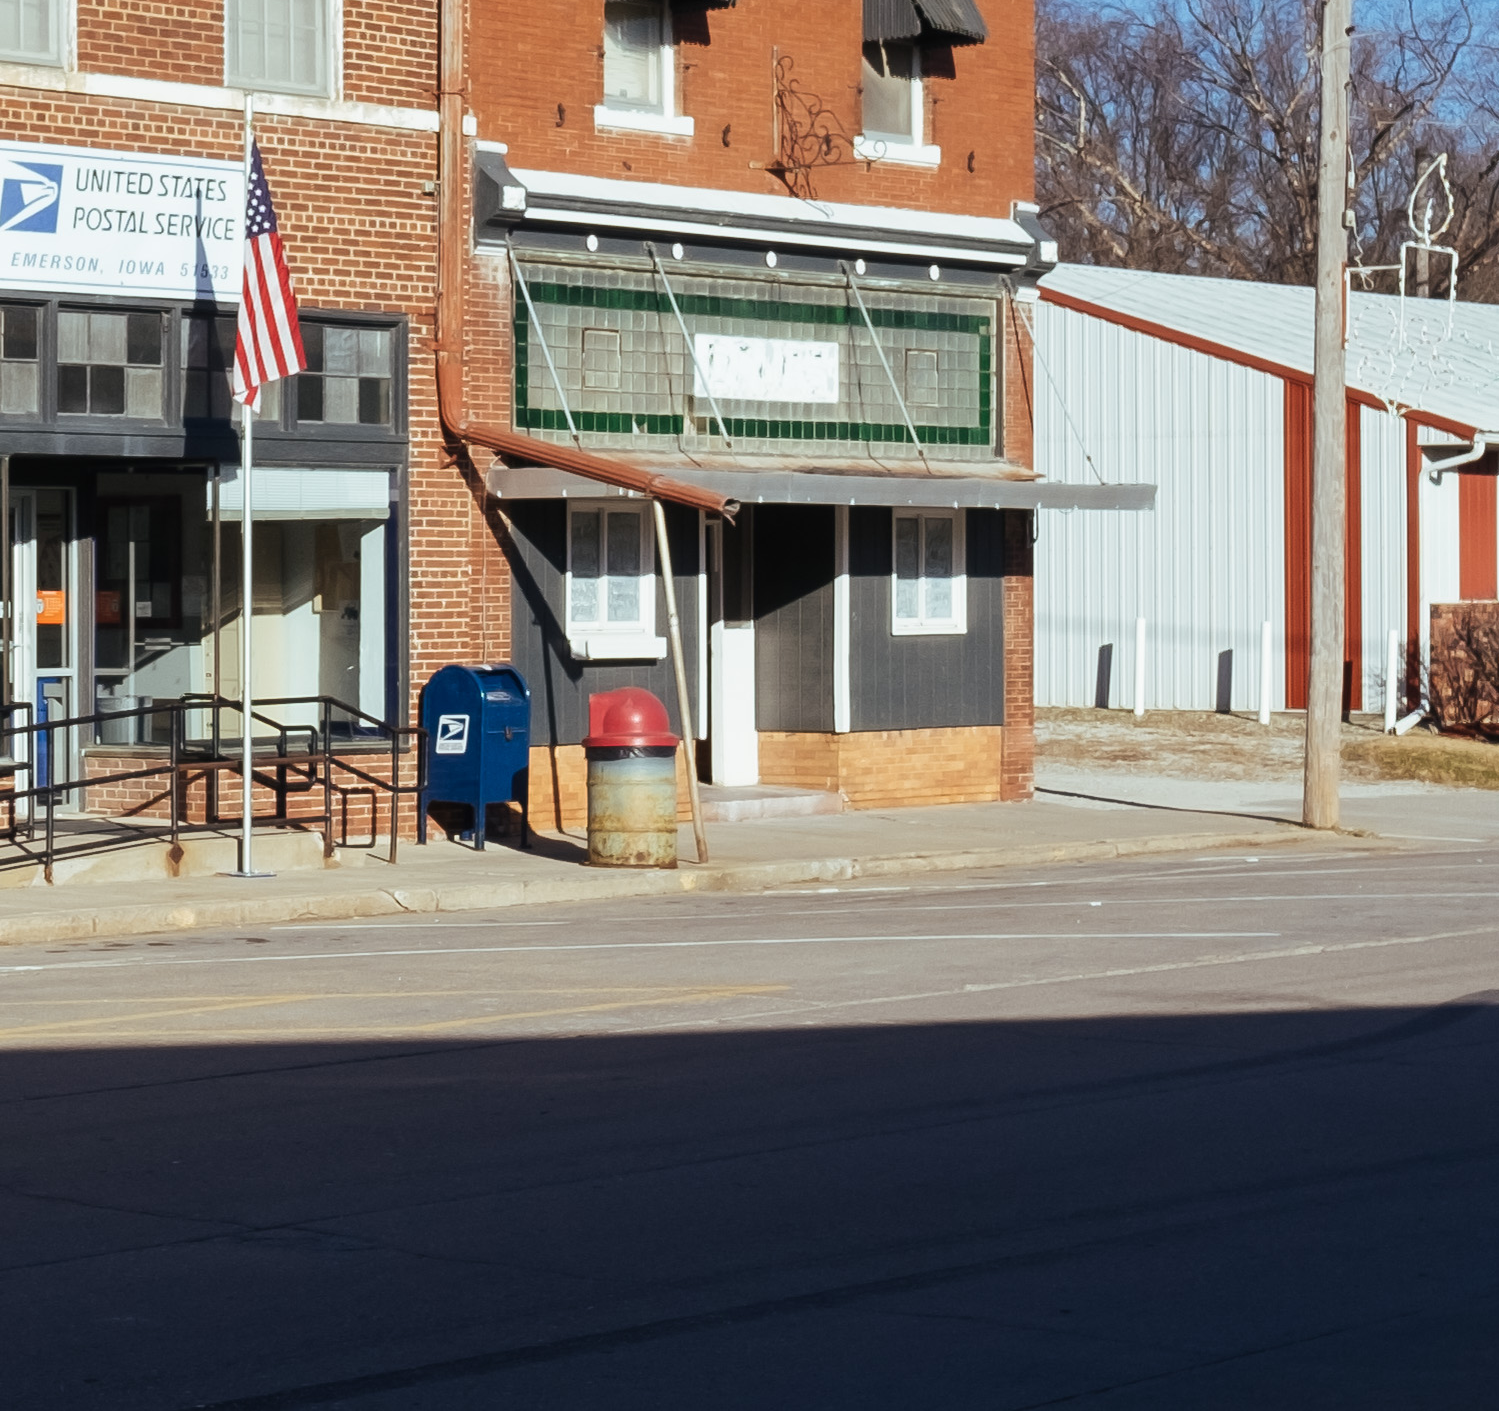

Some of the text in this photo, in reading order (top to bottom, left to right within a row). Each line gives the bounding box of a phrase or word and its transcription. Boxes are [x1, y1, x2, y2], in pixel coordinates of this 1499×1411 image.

[76, 168, 227, 201] UNITED STATES
[73, 207, 236, 241] POSTAL SERVICE
[10, 252, 229, 280] EMERSON, IOWA 51533
